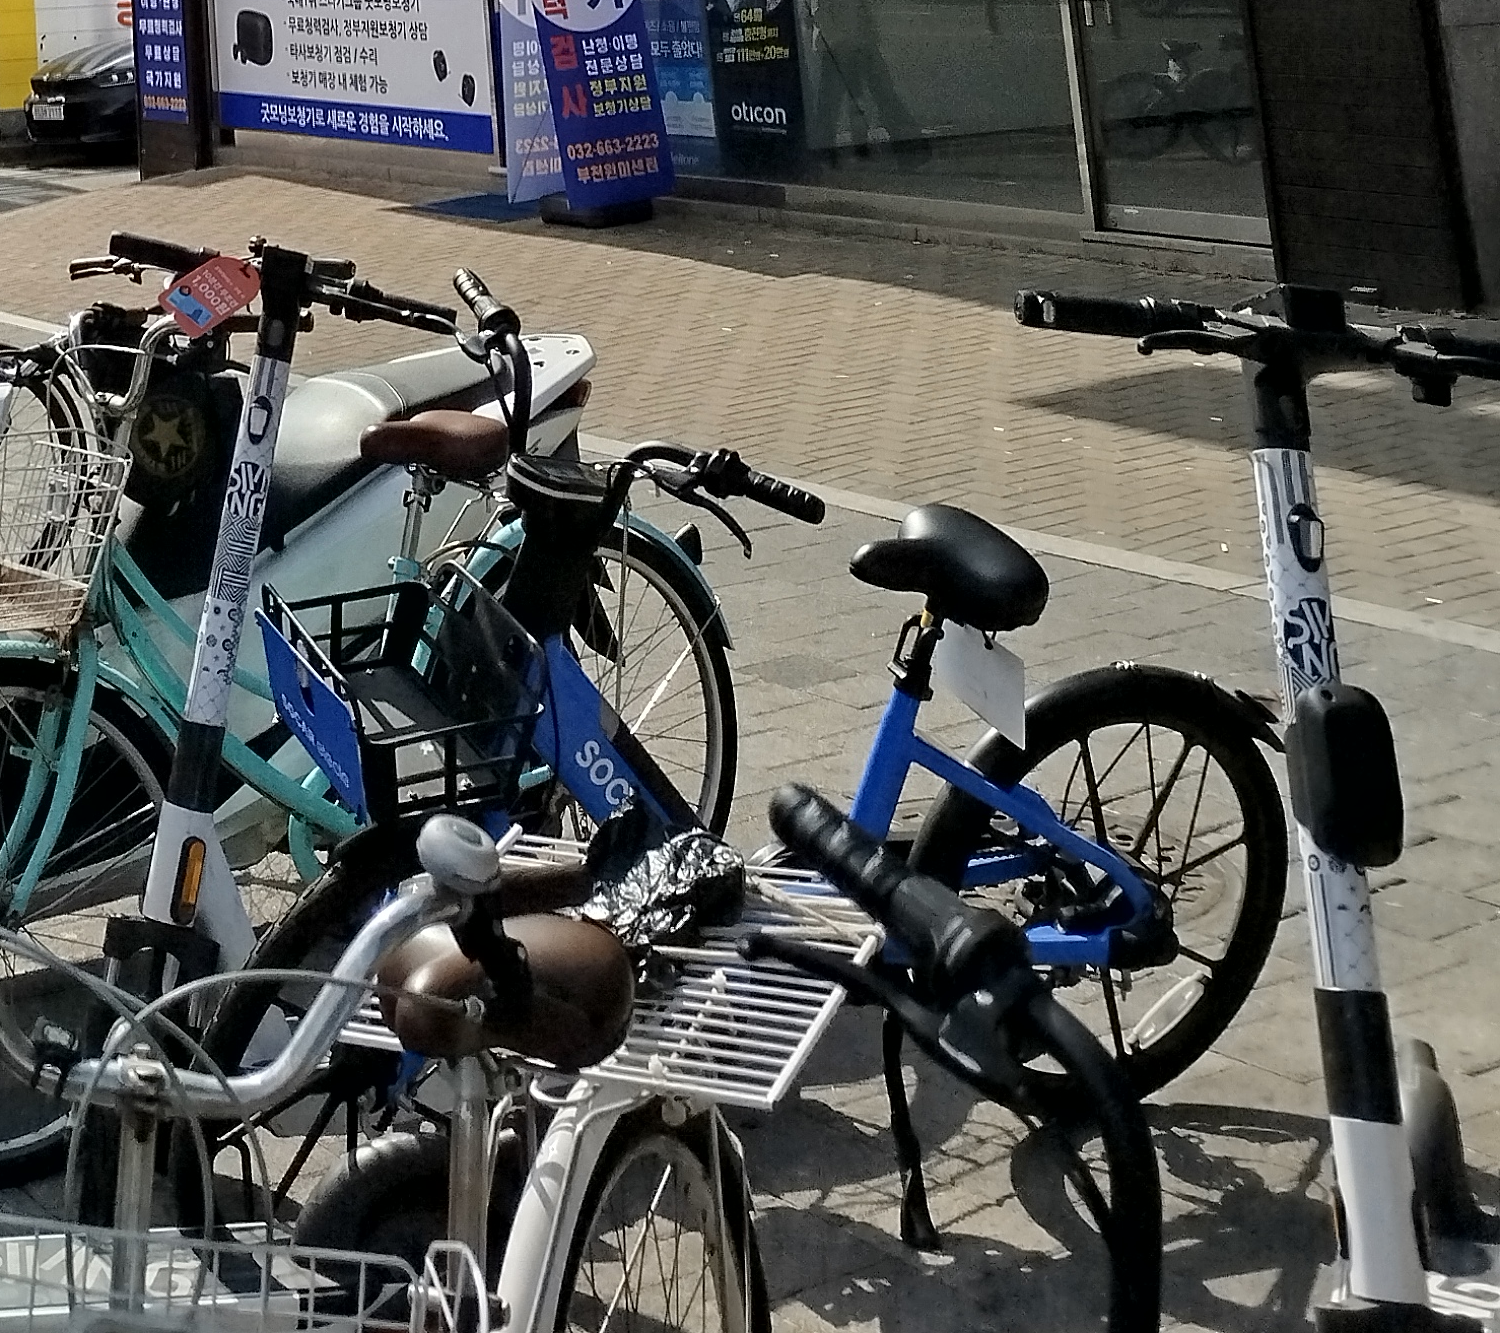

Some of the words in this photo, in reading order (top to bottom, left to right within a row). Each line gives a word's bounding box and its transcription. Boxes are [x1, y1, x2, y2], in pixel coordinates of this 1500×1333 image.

[343, 18, 407, 41] 정부지원보청기
[581, 33, 639, 57] 난청·이명
[585, 52, 643, 76] 전문상담
[291, 68, 318, 90] 보청기
[589, 73, 648, 98] 정부지원
[260, 101, 326, 129] 굿모닝보청기로
[593, 96, 652, 118] 보청기상담
[731, 101, 787, 125] oticon
[566, 132, 660, 162] 032-663-2223
[574, 739, 630, 806] SOC
